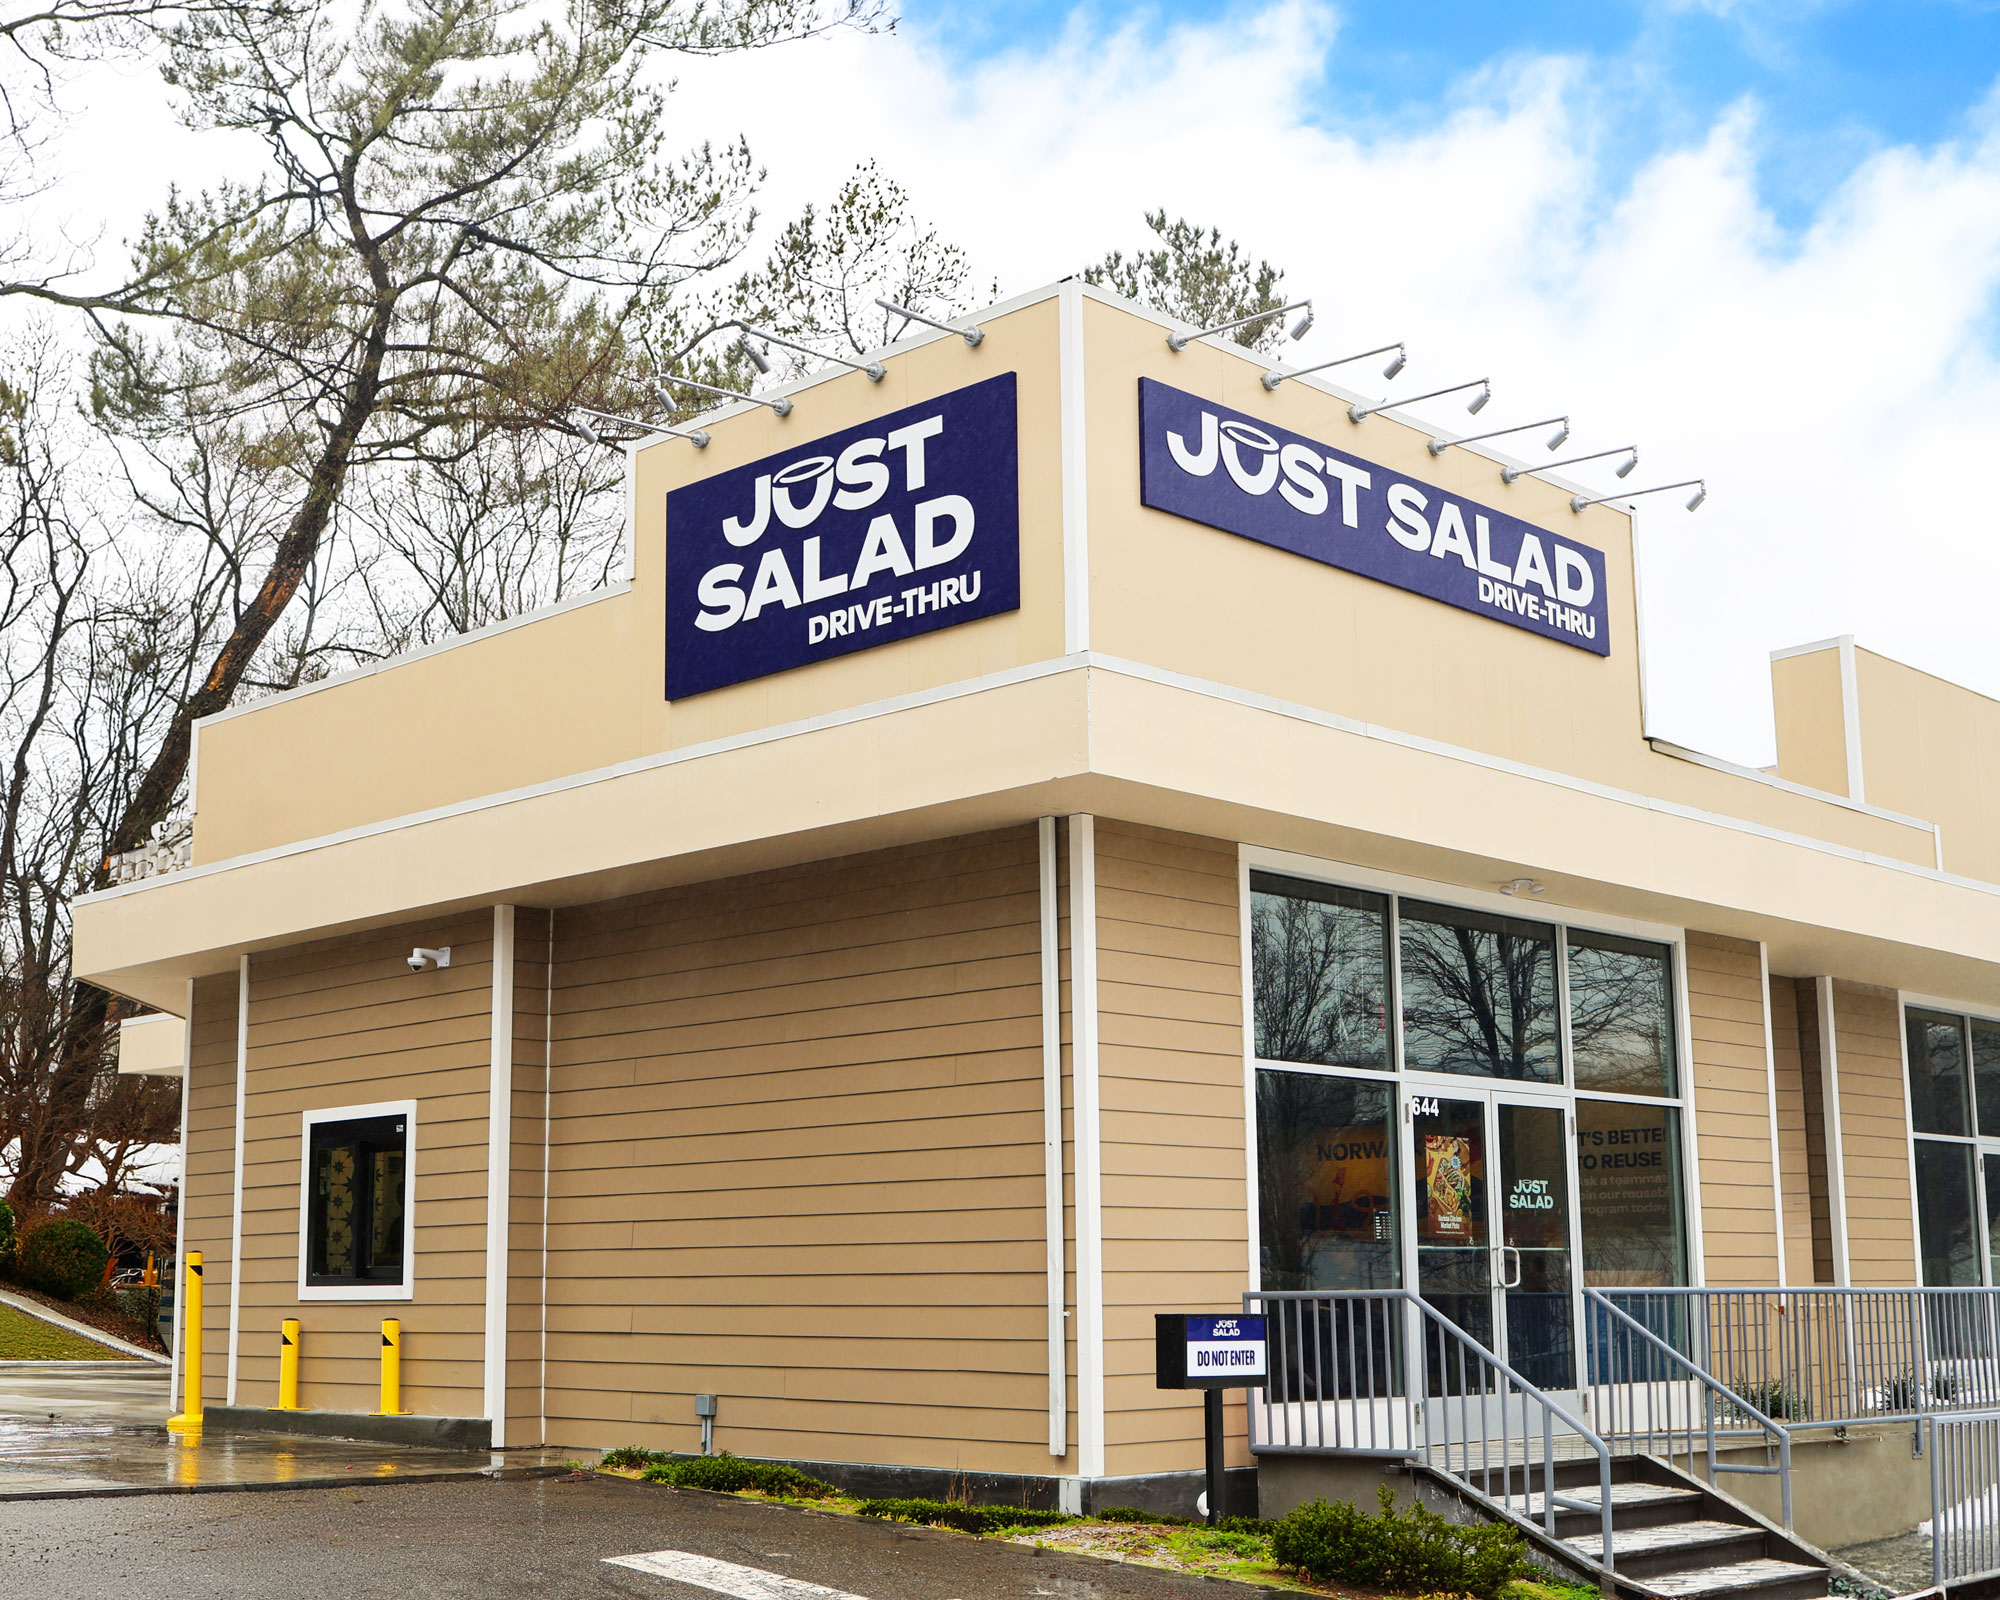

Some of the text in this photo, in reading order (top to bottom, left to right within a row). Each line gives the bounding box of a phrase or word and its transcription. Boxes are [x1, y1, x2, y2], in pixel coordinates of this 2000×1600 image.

[722, 414, 943, 547] JUST
[1166, 411, 1595, 607] JUST SALAD
[694, 494, 975, 632] SALAD
[808, 570, 981, 645] DRIVE-THRU
[1478, 576, 1596, 640] DRIVE-THRU
[1412, 1097, 1440, 1117] 644
[1577, 1130, 1604, 1146] T'S
[1317, 1140, 1421, 1161] NORW
[1601, 1151, 1662, 1169] REUSE
[1513, 1178, 1549, 1194] JUST
[1600, 1177, 1608, 1186] a
[1611, 1173, 1667, 1186] teammat
[1510, 1194, 1554, 1209] SALAD
[1580, 1186, 1668, 1201] oin our reusab
[1583, 1204, 1629, 1216] rogram
[1212, 1328, 1240, 1337] SALAD
[1215, 1319, 1238, 1329] JUST
[1197, 1350, 1255, 1367] DO NOT ENTER
